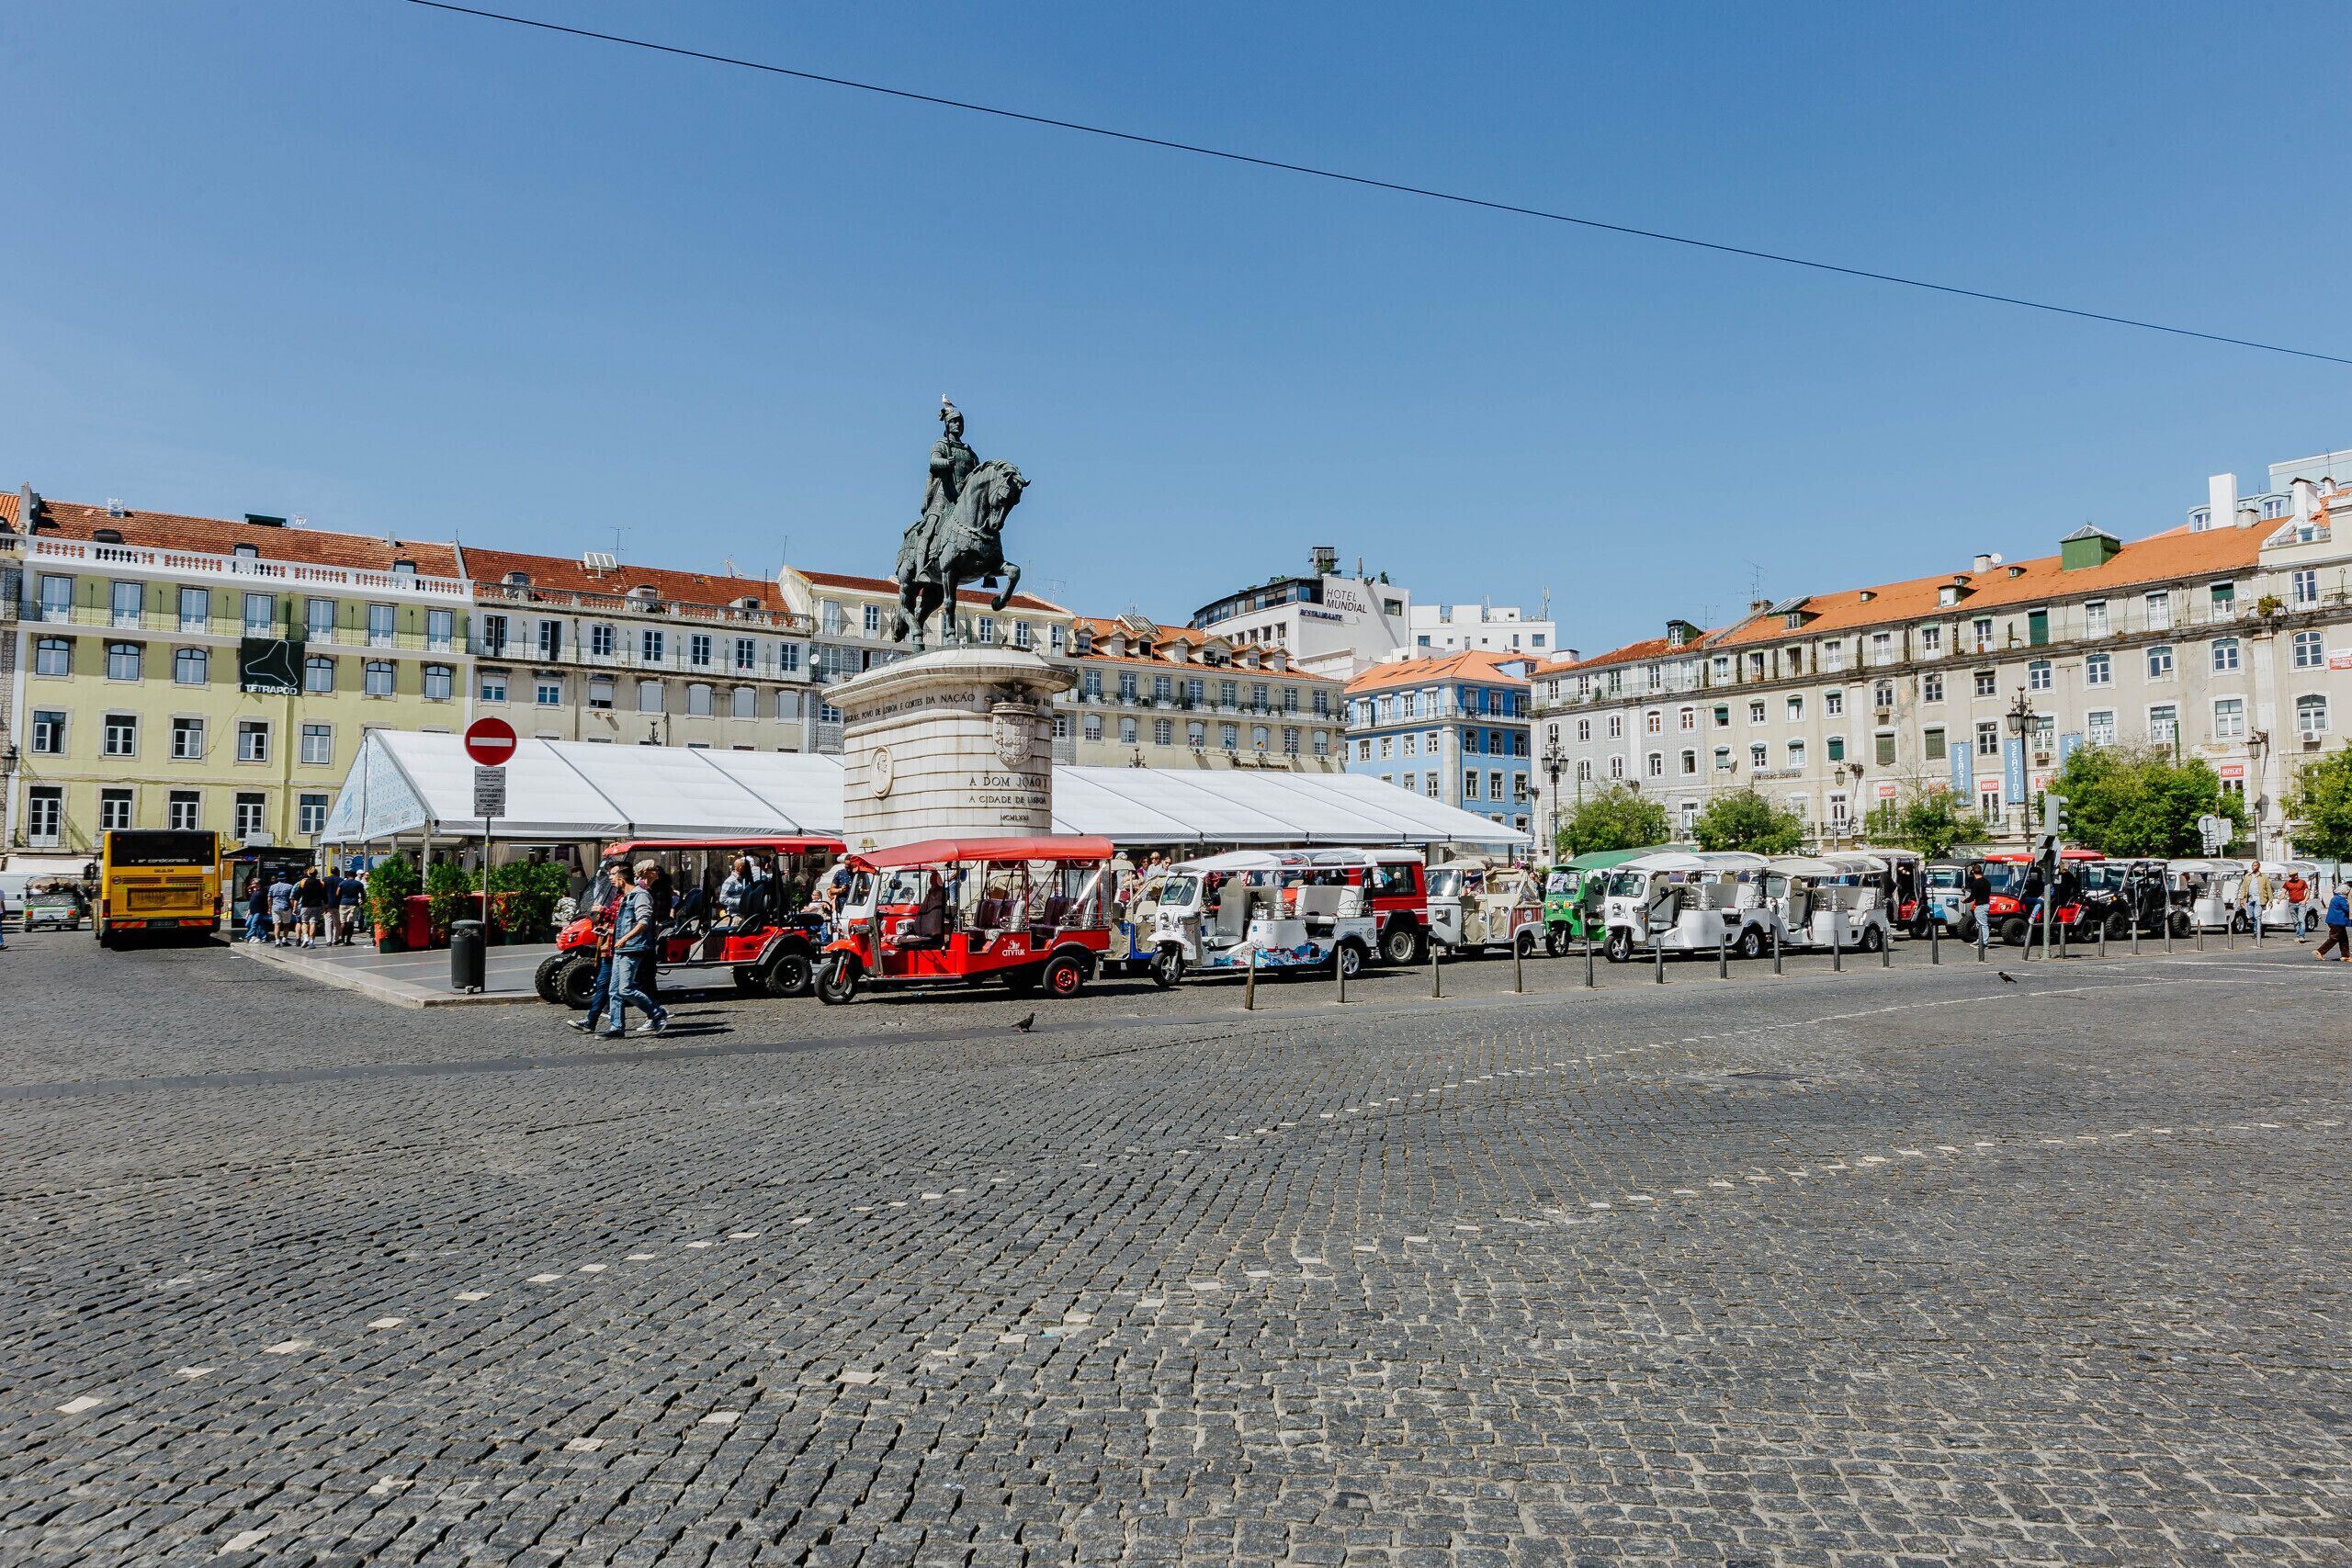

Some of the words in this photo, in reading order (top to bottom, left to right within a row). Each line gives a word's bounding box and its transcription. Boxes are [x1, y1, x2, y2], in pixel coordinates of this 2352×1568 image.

[1327, 589, 1357, 602] HOTEL
[1326, 599, 1367, 614] MUNDIAL
[245, 683, 298, 695] TETRAPOD
[883, 705, 899, 715] LISBOA
[925, 696, 936, 705] DA
[1957, 746, 1965, 791] SEASI
[2011, 742, 2019, 799] SEASIDE
[968, 777, 977, 786] A
[983, 776, 1011, 787] DOM
[1016, 776, 1041, 788] JOÃO
[1043, 778, 1047, 788] I
[968, 795, 976, 804] A
[978, 795, 1012, 804] CIDADE
[1015, 795, 1025, 804] DE
[1027, 795, 1046, 805] LISBOA
